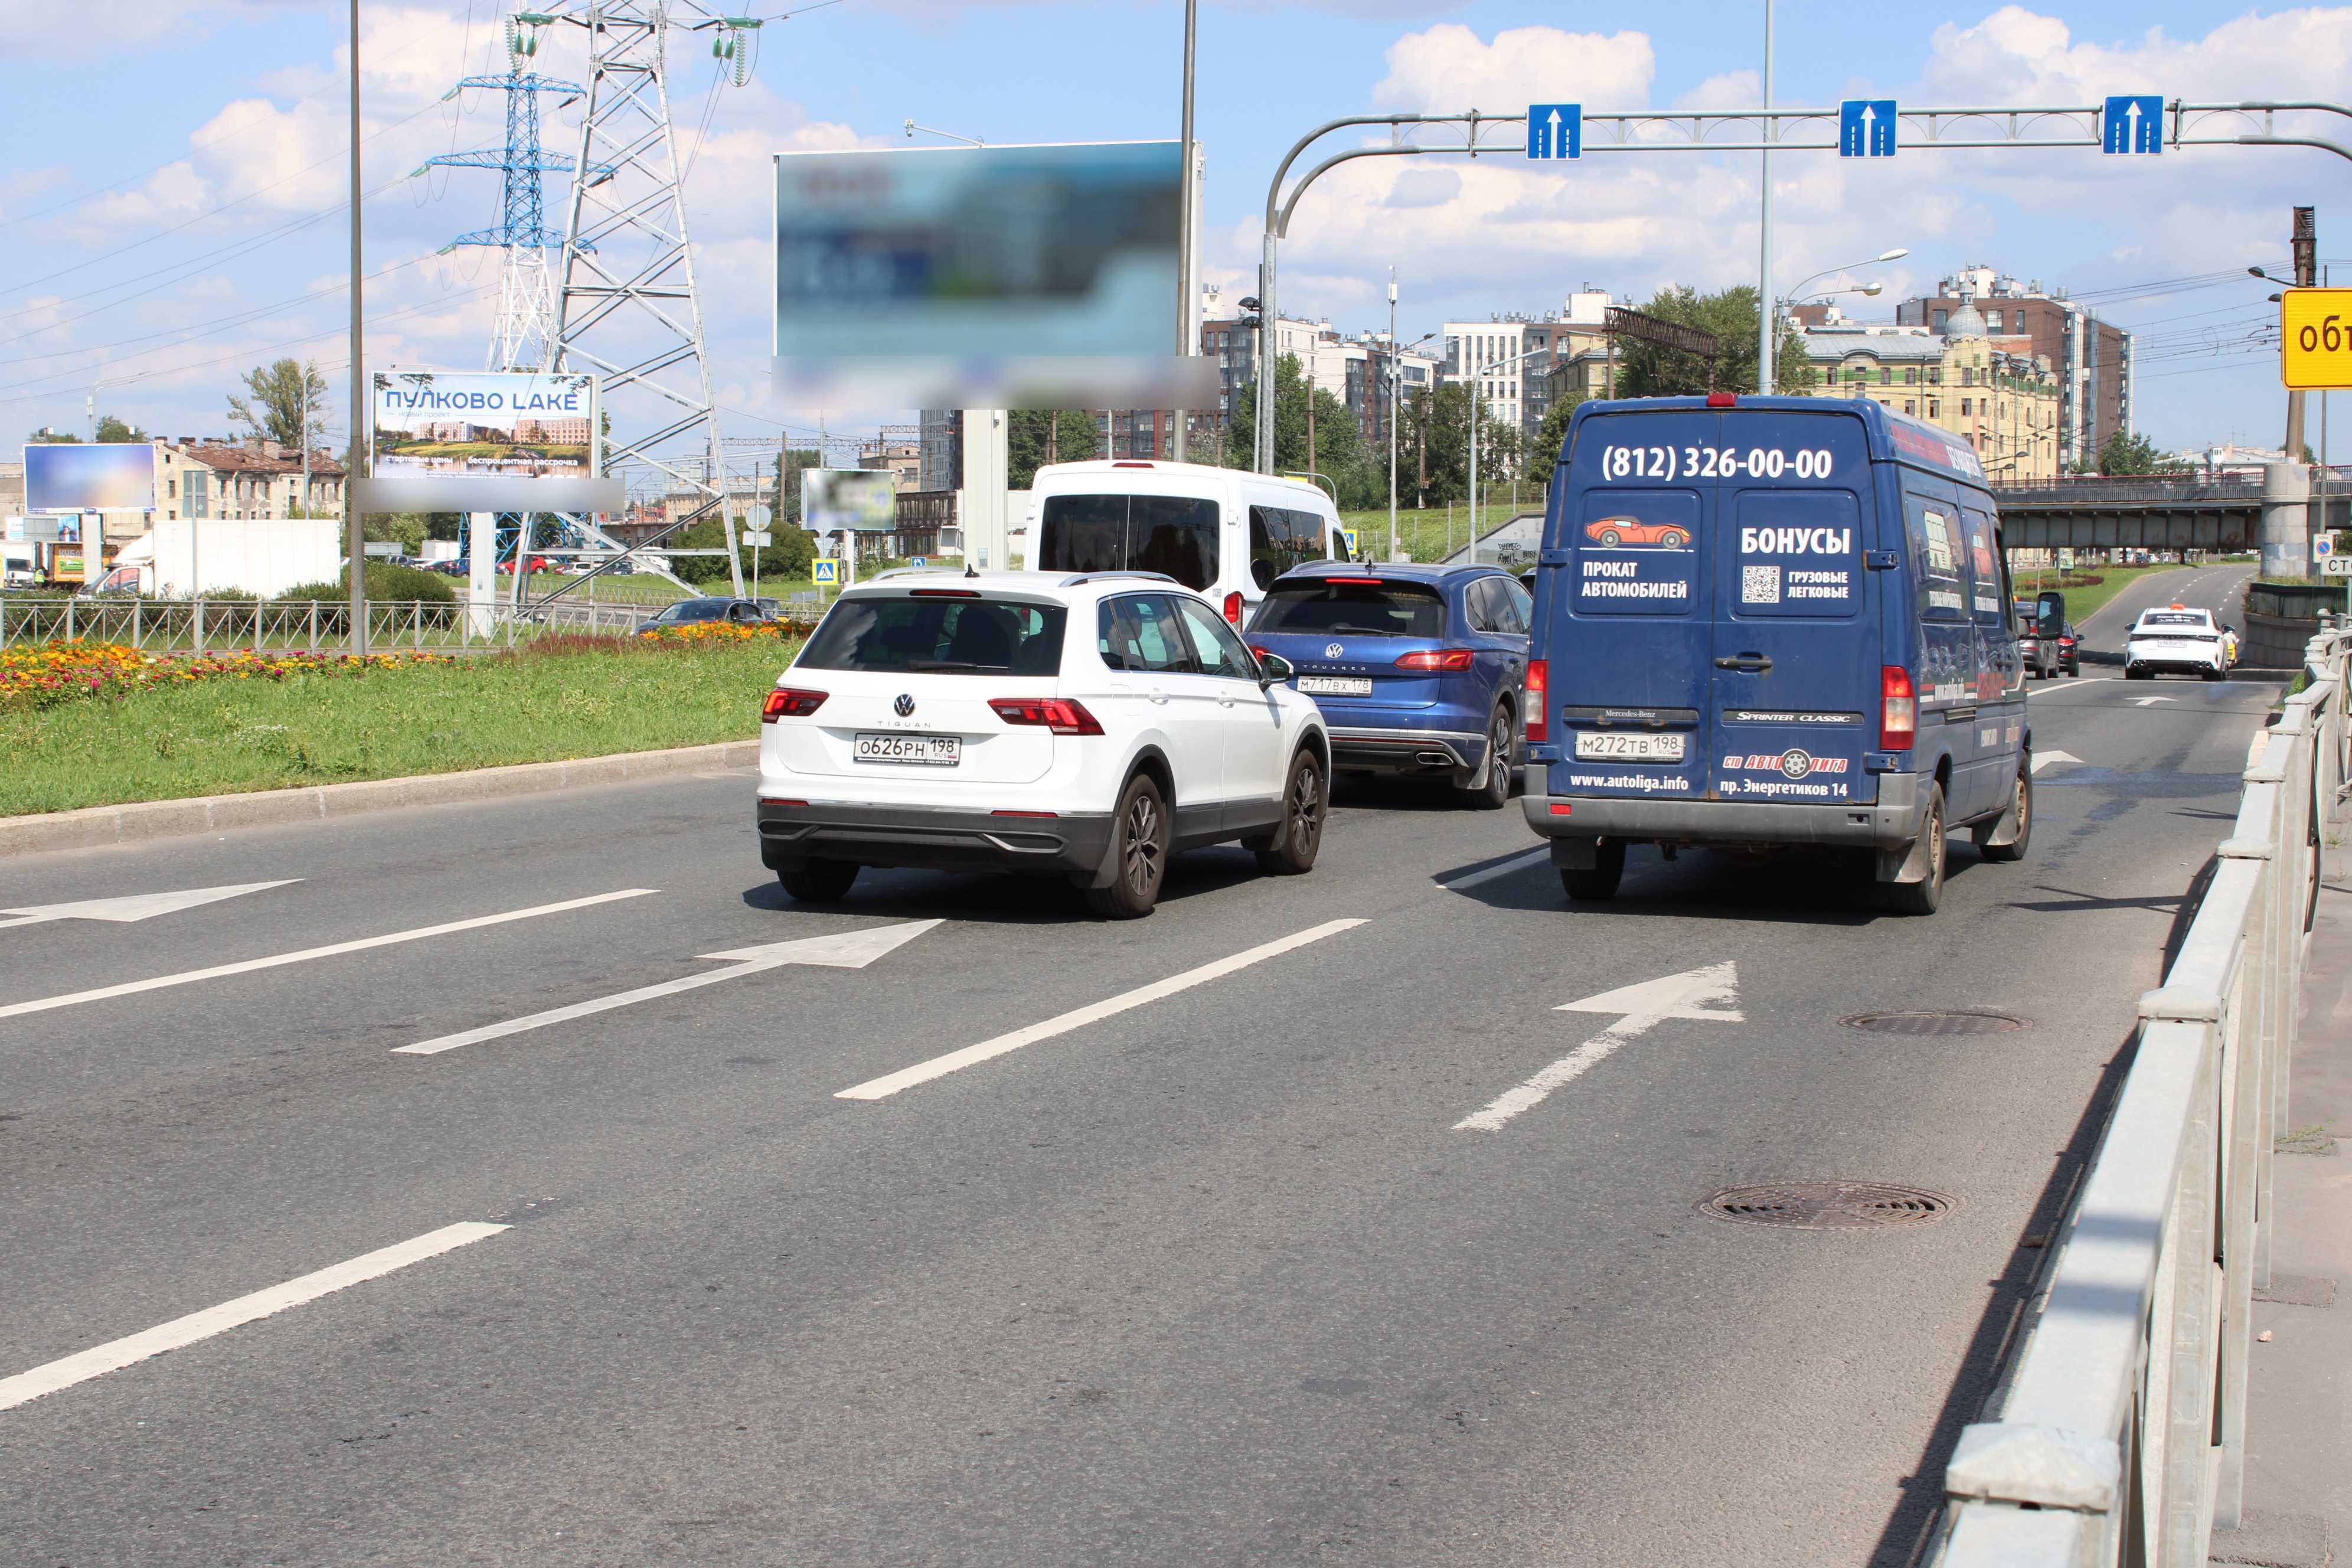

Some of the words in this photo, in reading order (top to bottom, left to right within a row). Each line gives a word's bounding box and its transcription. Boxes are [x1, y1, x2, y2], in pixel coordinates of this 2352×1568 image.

[387, 391, 504, 409] ПУЛКОВО
[513, 393, 578, 410] LAKE
[468, 457, 533, 466] беспроцентная
[1602, 446, 1677, 481] (812)
[1683, 448, 1832, 479] 326-00-00
[1742, 528, 1850, 554] БОНУСЫ
[1583, 561, 1638, 577] ПРОКАТ
[2328, 560, 2352, 571] СТ
[1788, 571, 1848, 584] ГРУЗОВЫЕ
[1581, 580, 1687, 599] АВТОМОБИЛЕЙ
[1787, 586, 1849, 599] ЛЕГКОВЫЕ
[1352, 679, 1369, 689] 178
[1605, 710, 1656, 718] Mercedes-Benz
[1799, 714, 1851, 723] CLASSIC
[877, 720, 932, 729] TIGUAN
[861, 737, 926, 756] О626РН
[930, 739, 955, 753] 198
[1583, 736, 1649, 754] М272ТВ
[1653, 736, 1678, 749] 198
[1724, 756, 1742, 767] СТО
[1570, 775, 1689, 790] www.autoliga.info
[1720, 780, 1741, 795] пр.
[1743, 779, 1829, 796] Энергетиков
[1832, 783, 1848, 796] 14
